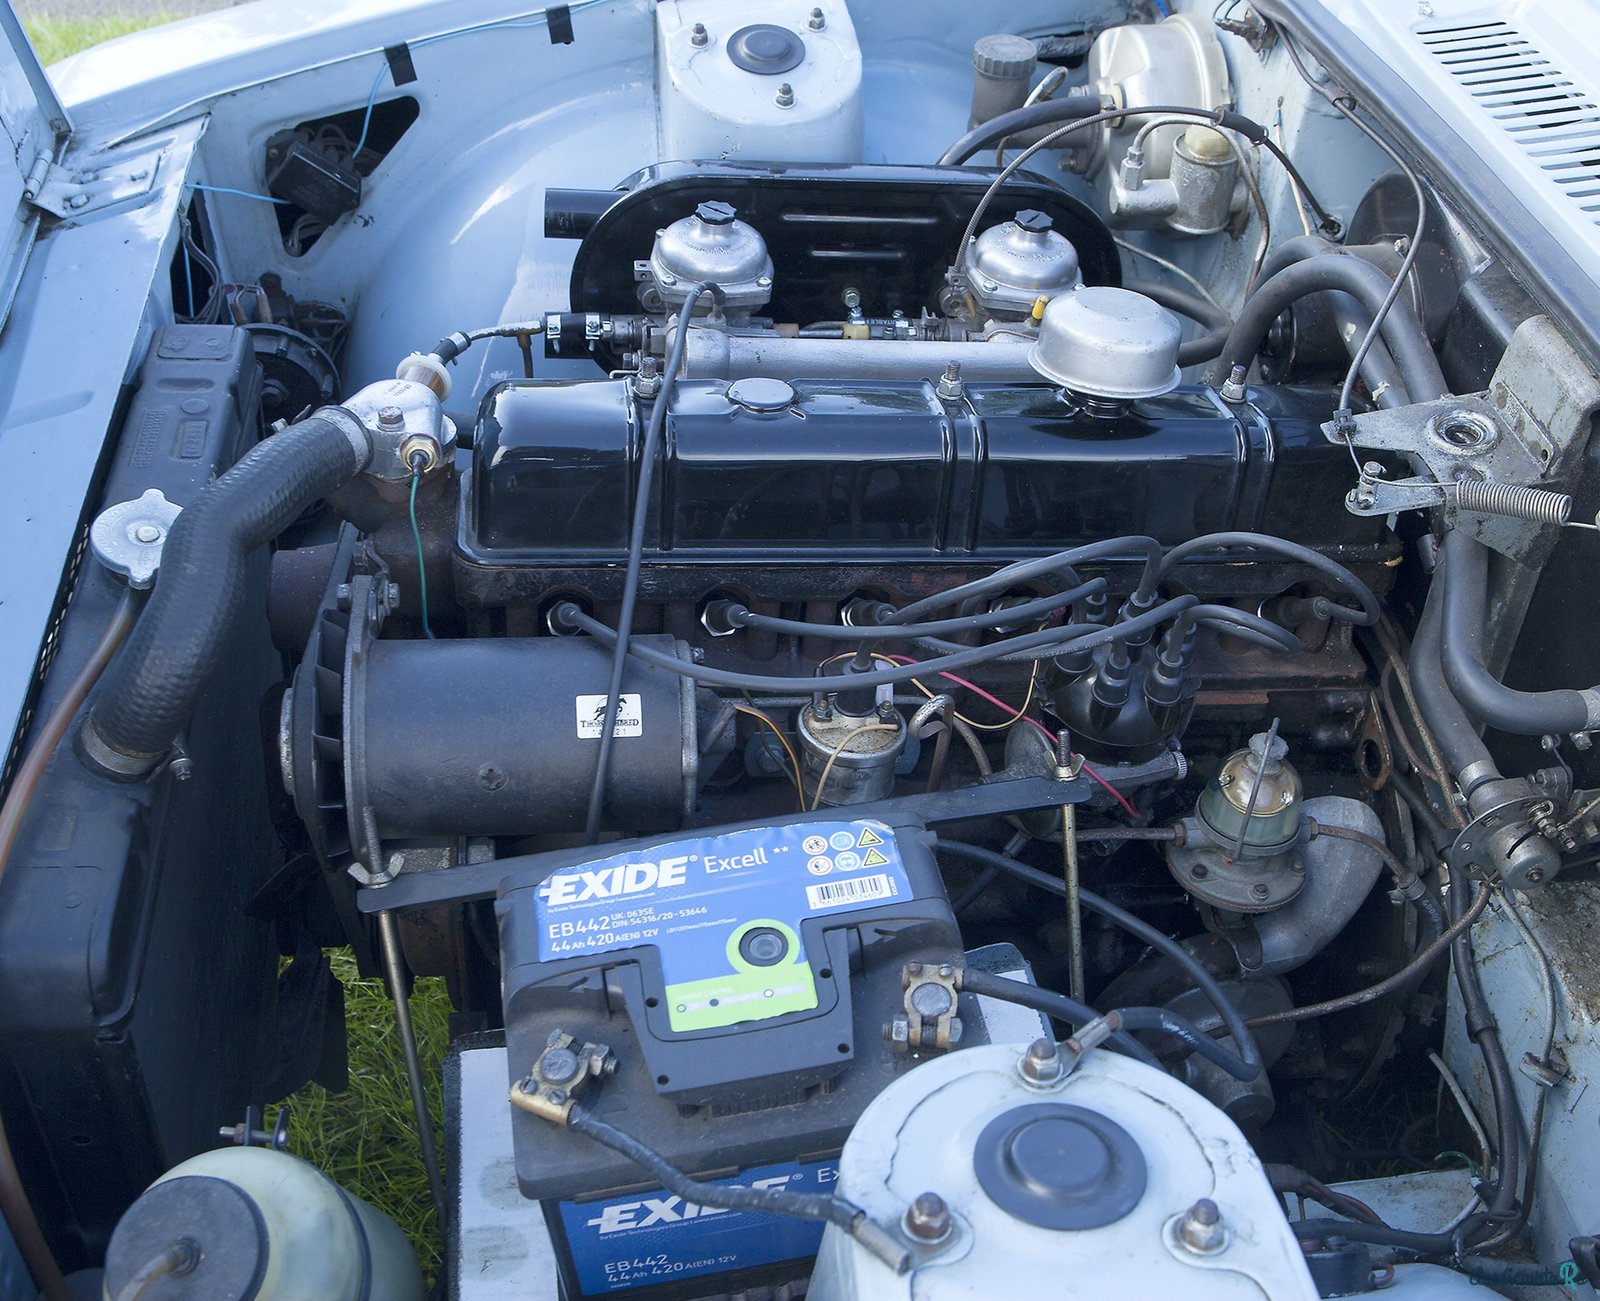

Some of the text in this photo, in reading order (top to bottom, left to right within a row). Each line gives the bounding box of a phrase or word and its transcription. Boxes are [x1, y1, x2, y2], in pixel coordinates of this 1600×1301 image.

[704, 847, 769, 874] Excell
[540, 856, 689, 907] EXIDE
[549, 916, 611, 939] EB442
[604, 1254, 669, 1275] EB442
[718, 1254, 737, 1264] 12V
